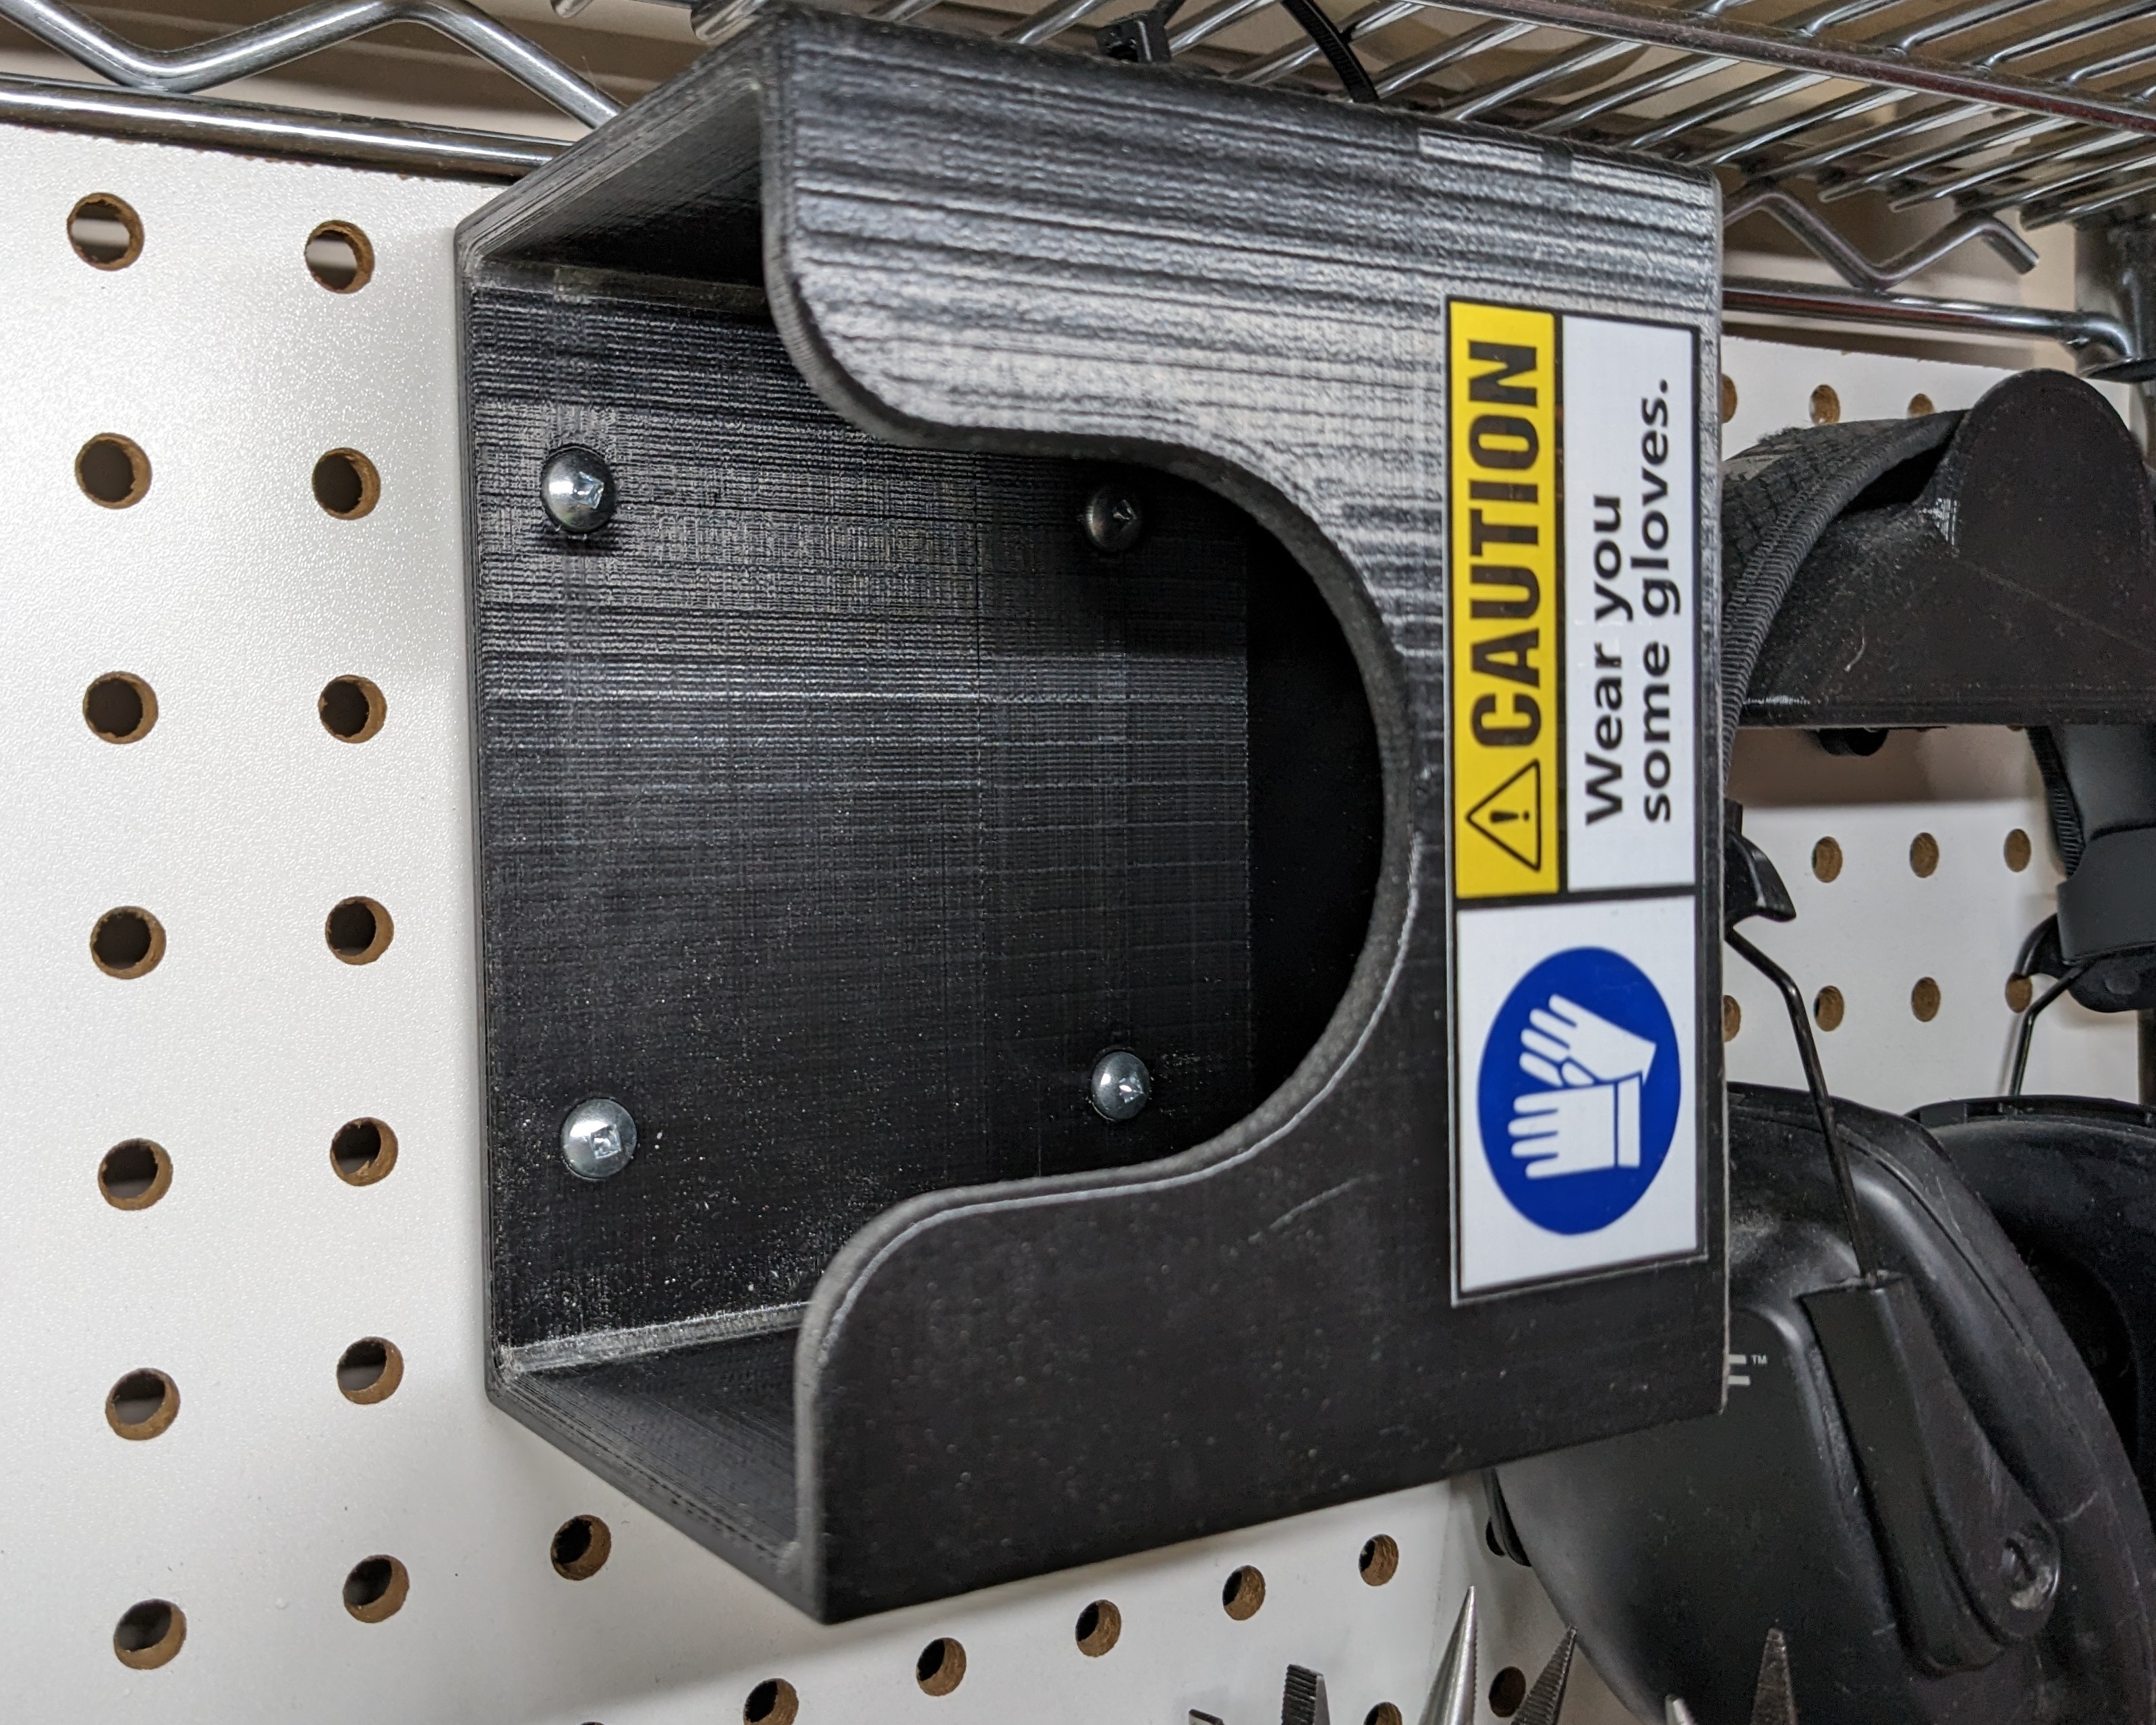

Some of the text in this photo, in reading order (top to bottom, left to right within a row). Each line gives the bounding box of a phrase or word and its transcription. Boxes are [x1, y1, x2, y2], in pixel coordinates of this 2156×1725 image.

[1468, 339, 1541, 748] CAUTION
[1585, 496, 1633, 824] Wear you
[1631, 378, 1680, 823] some gloves.
